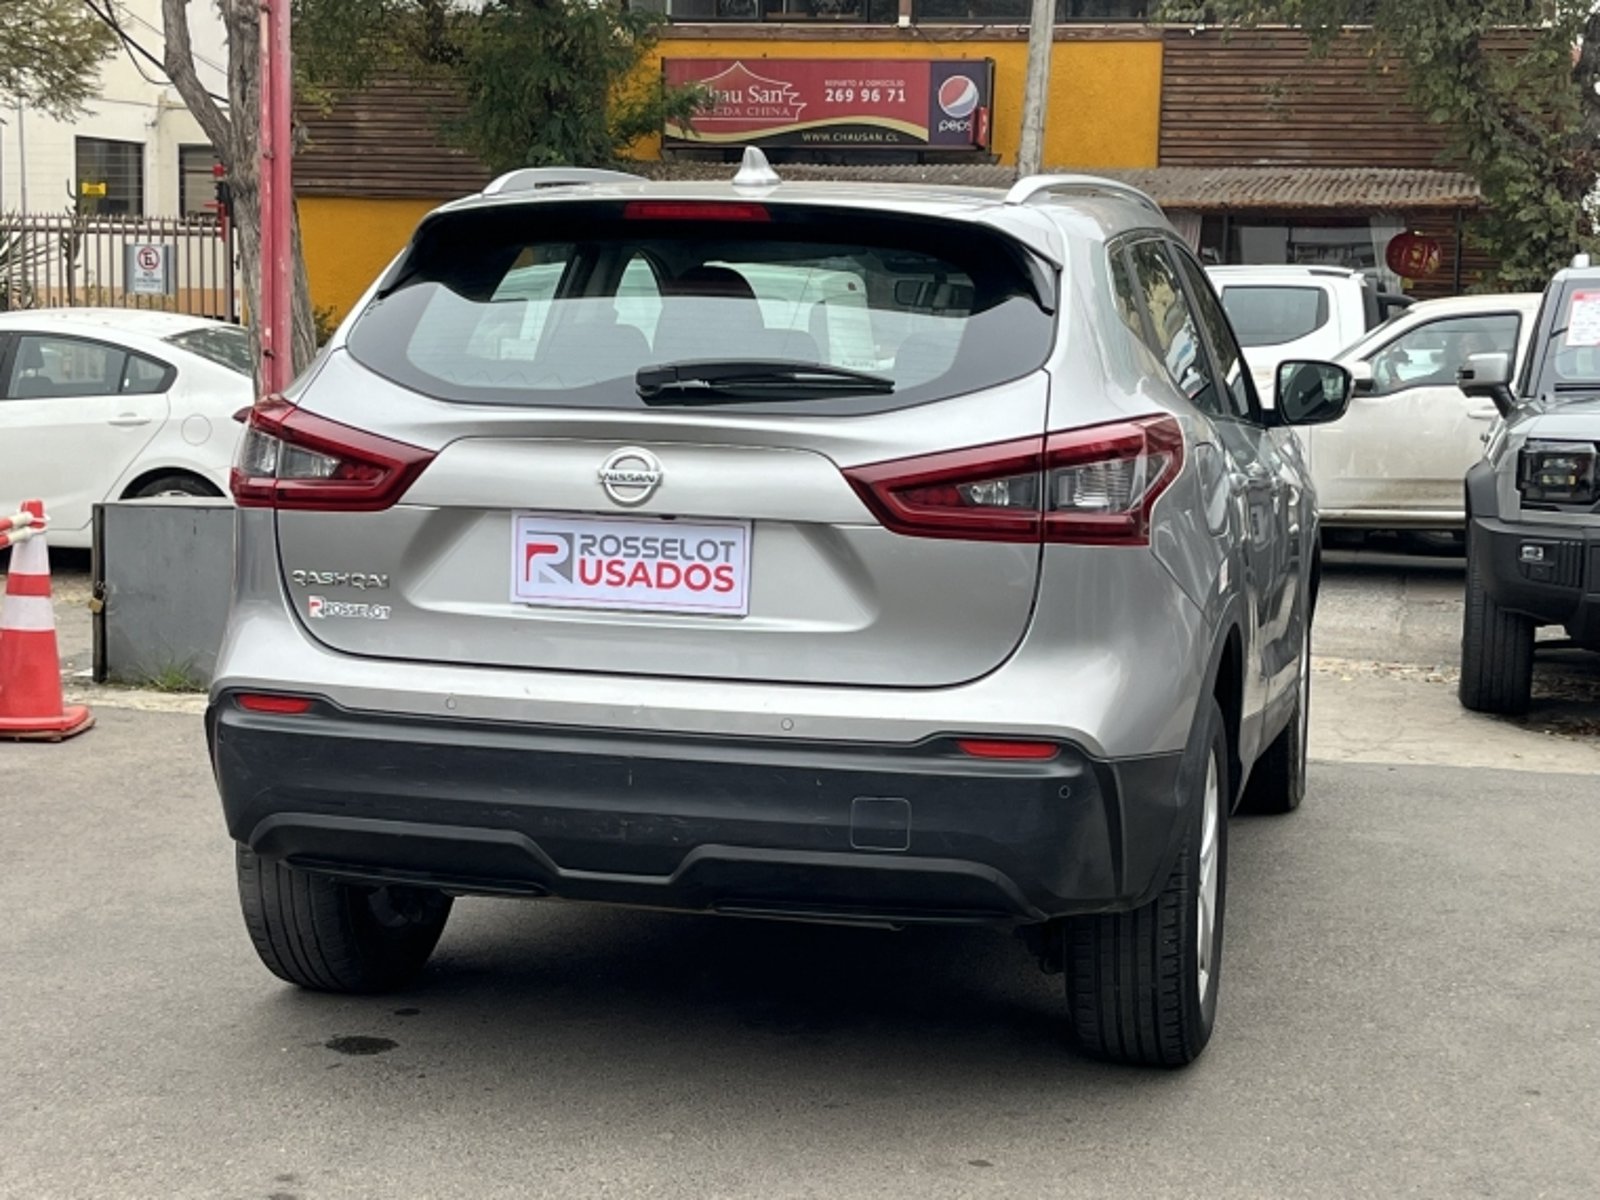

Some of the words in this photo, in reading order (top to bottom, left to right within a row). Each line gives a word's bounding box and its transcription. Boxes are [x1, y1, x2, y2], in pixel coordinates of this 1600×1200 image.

[748, 85, 783, 103] San
[824, 88, 854, 102] 269
[860, 88, 881, 102] 96
[887, 88, 906, 102] 71
[746, 106, 791, 117] CHINA
[603, 472, 656, 483] NISSAN
[579, 534, 736, 563] ROSSELOT
[292, 569, 390, 590] QASHQAI
[578, 559, 735, 593] USADOS
